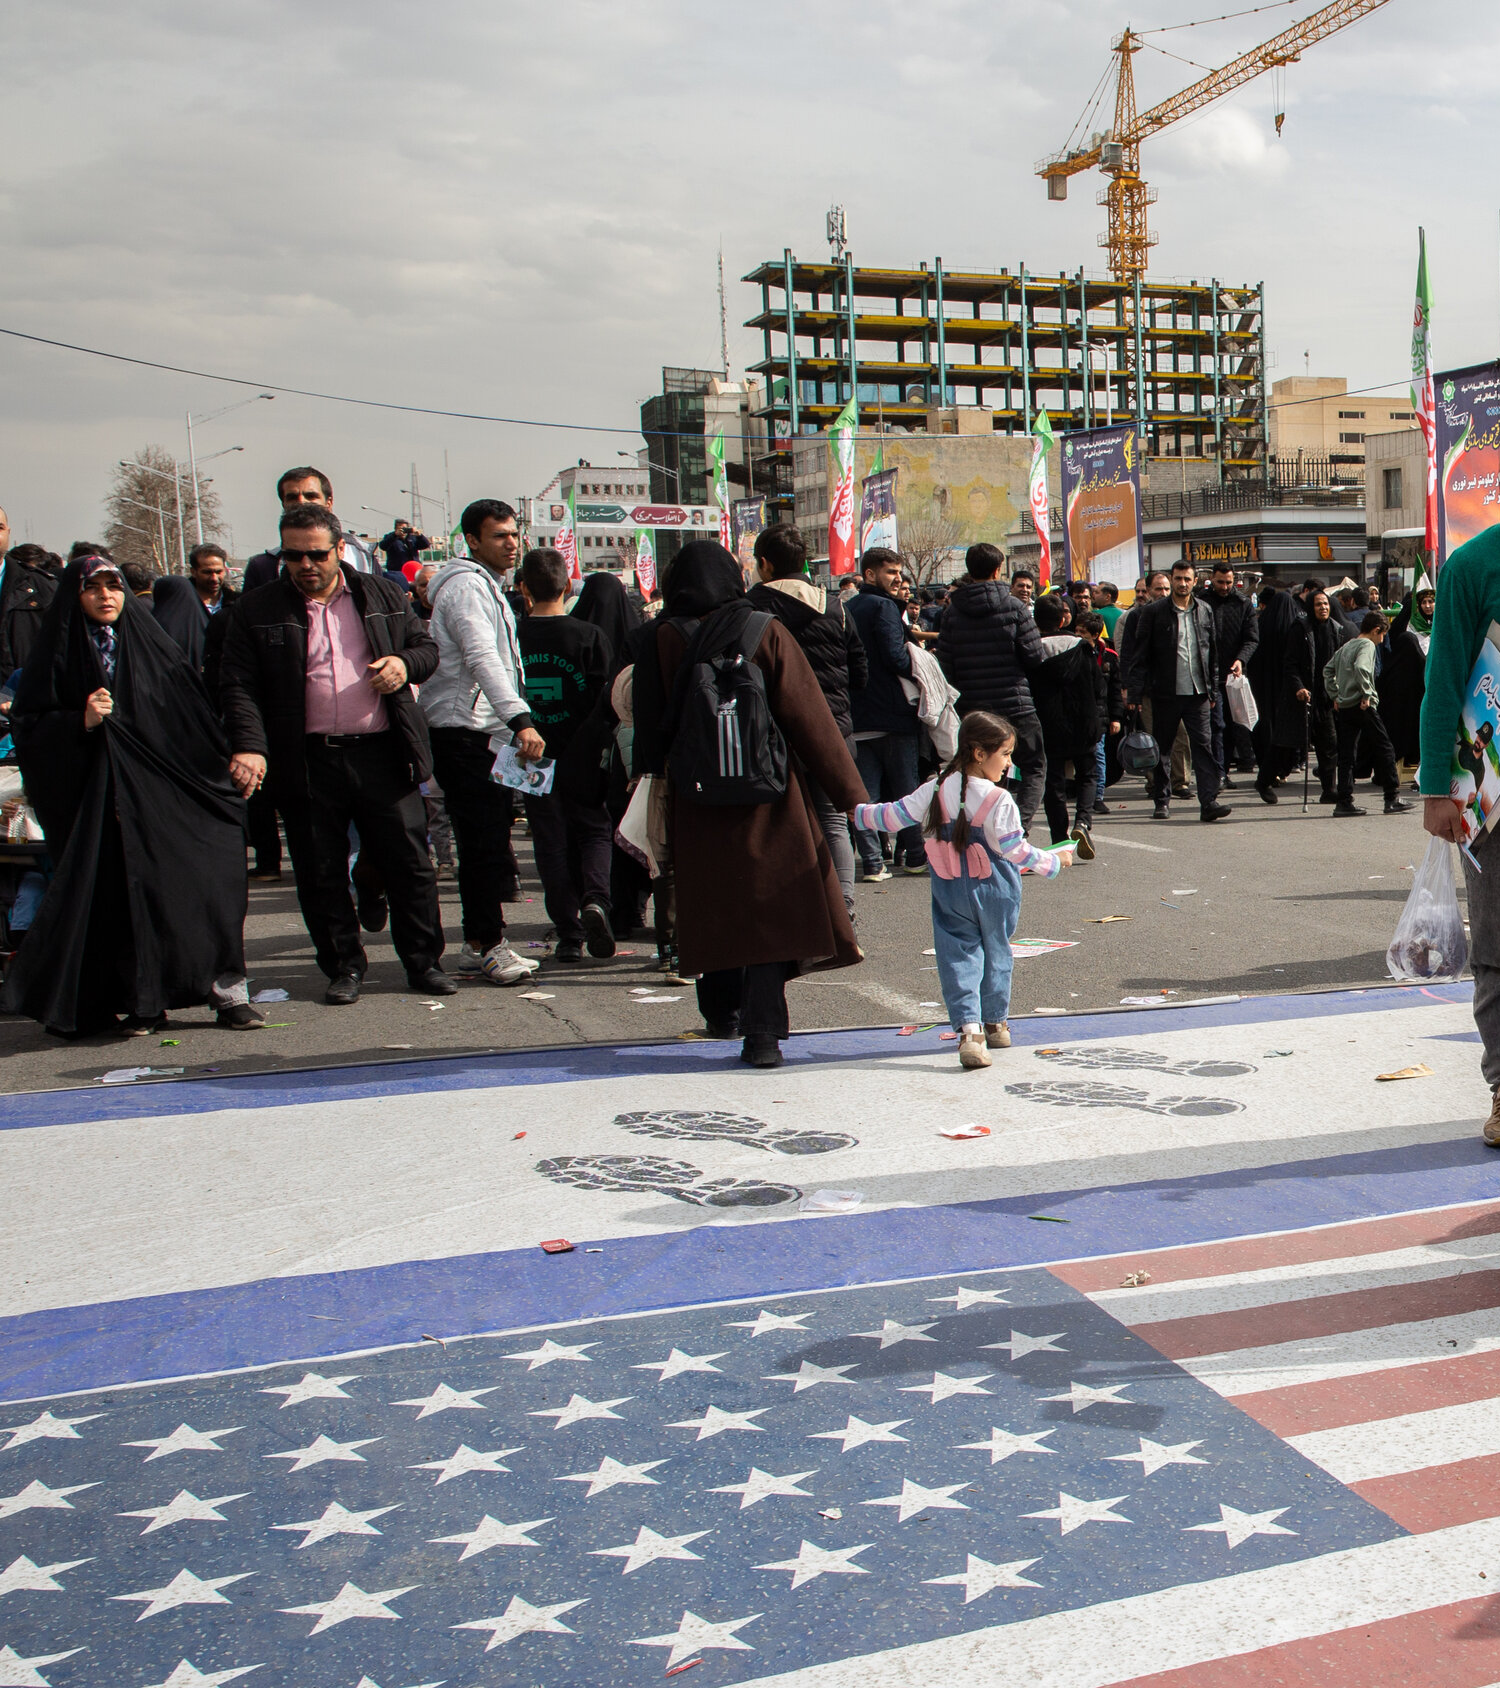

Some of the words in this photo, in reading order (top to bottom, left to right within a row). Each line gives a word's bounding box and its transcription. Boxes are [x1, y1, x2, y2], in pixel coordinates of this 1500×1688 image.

[1195, 542, 1229, 563] پاسارگاد
[1229, 541, 1248, 563] بانک
[522, 653, 549, 666] EMIS
[552, 655, 575, 673] TOO
